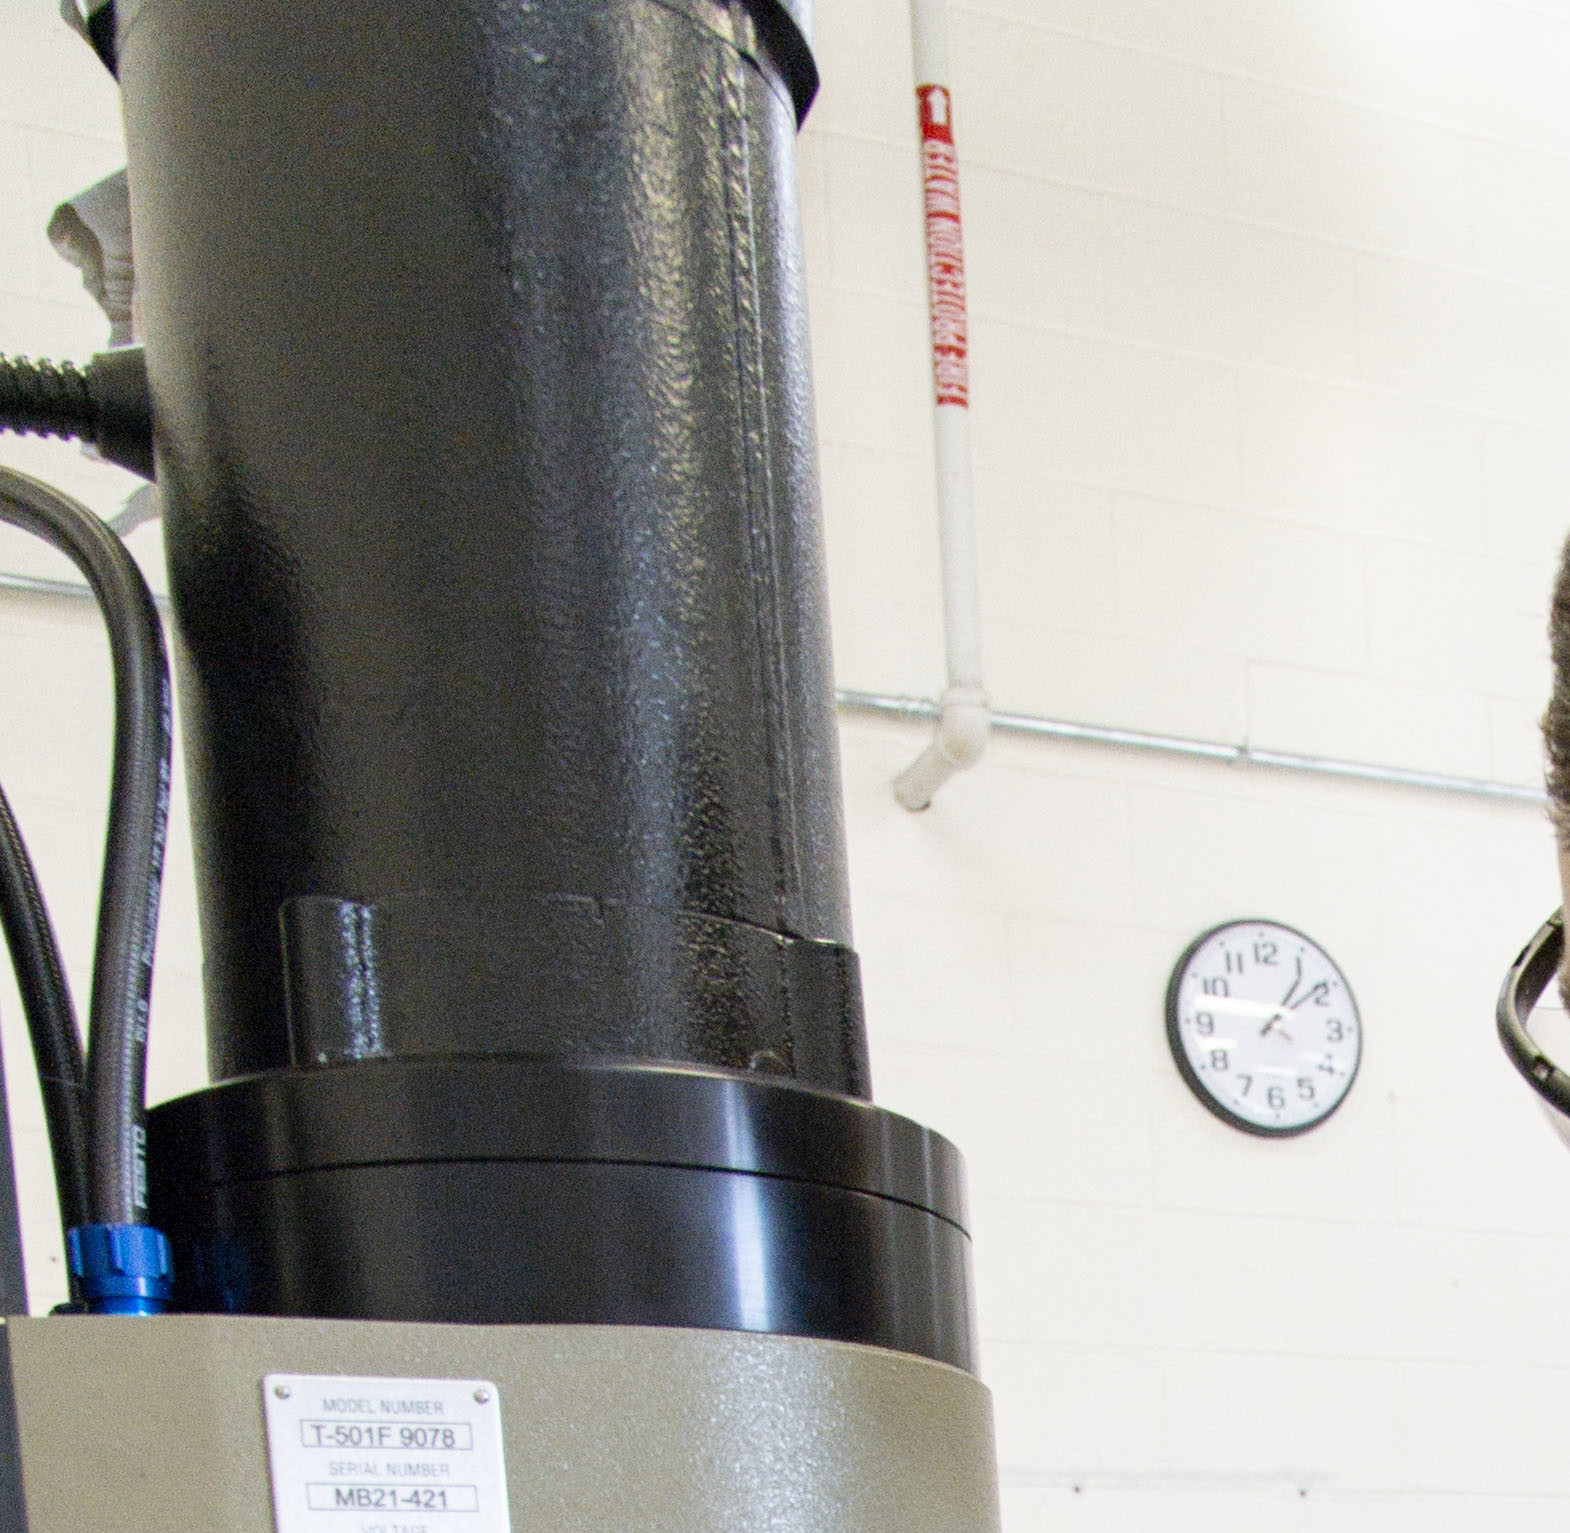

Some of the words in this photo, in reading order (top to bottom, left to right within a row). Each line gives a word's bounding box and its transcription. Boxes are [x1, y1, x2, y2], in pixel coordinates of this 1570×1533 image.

[1225, 951, 1244, 974] 11
[1254, 942, 1278, 966] 12
[1196, 1013, 1214, 1036] 9
[1326, 1020, 1343, 1042] 3
[1210, 1049, 1229, 1071] 8
[1237, 1075, 1253, 1097] 7
[1297, 1077, 1316, 1100] 5
[1267, 1087, 1285, 1110] 6
[323, 1398, 376, 1414] MODEL
[380, 1399, 444, 1415] NUMBER
[310, 1424, 392, 1446] T-501F
[400, 1427, 455, 1448] 9078
[329, 1461, 382, 1476] SERIAL
[386, 1463, 450, 1478] NUMBER
[334, 1488, 447, 1509] MB21-421
